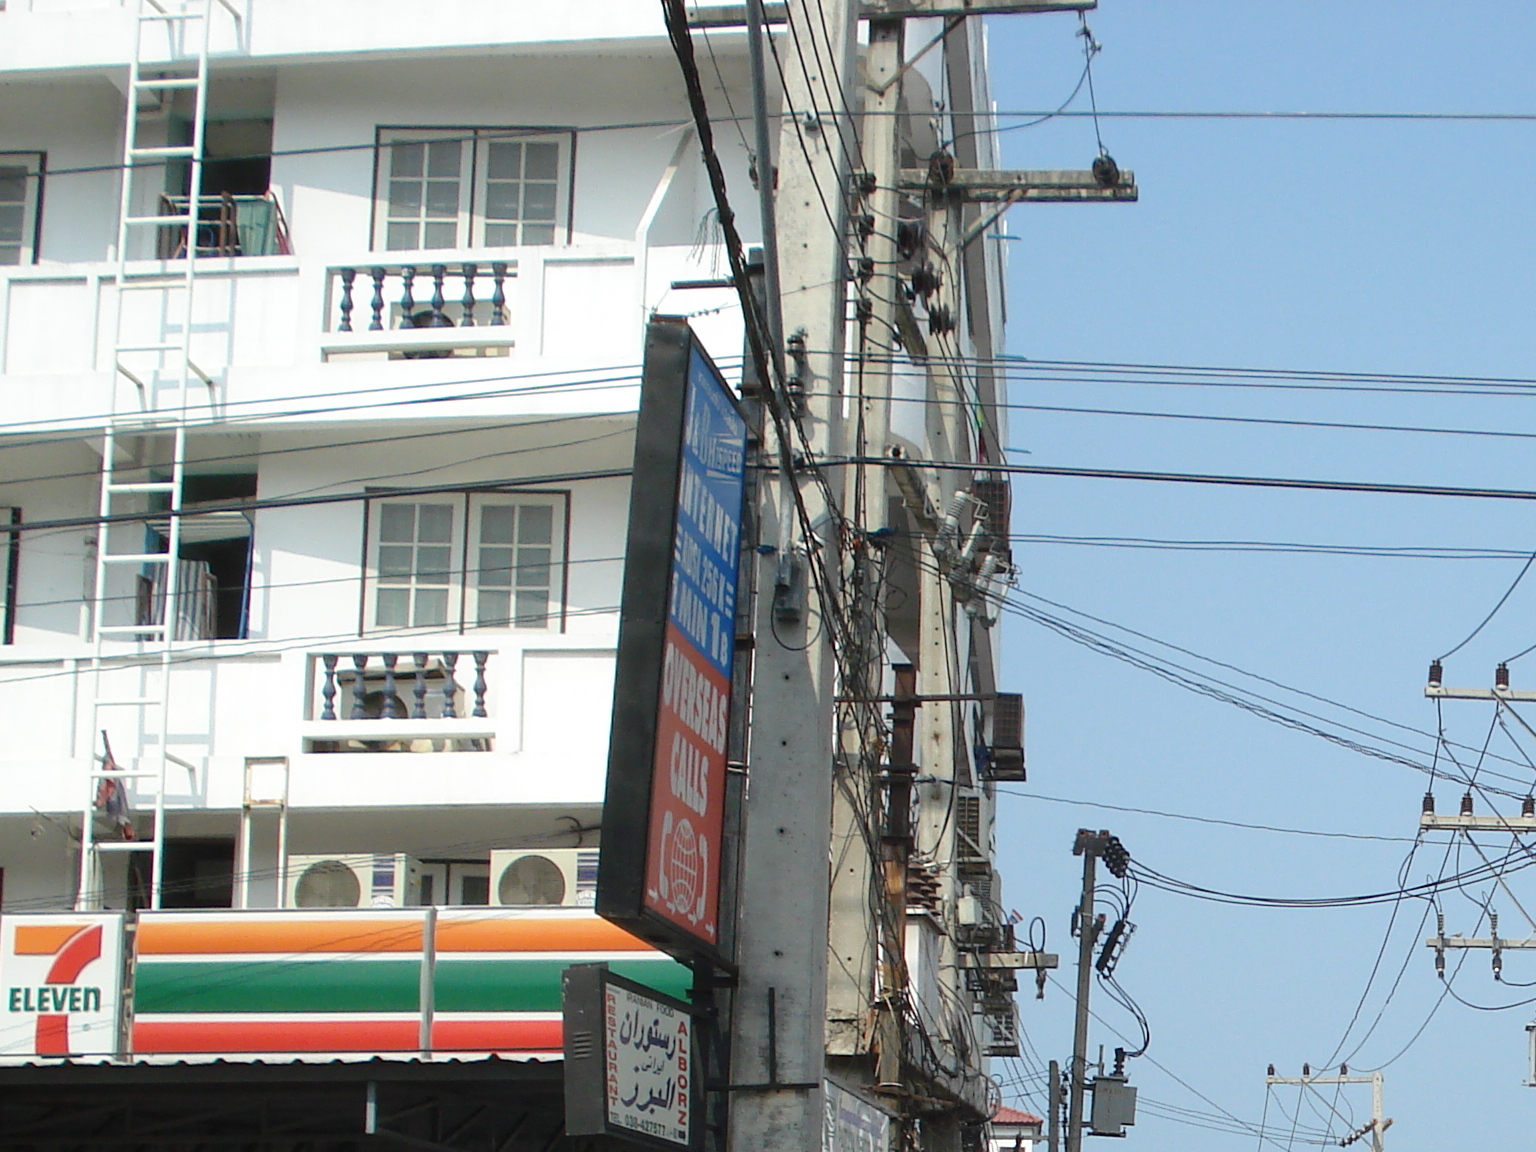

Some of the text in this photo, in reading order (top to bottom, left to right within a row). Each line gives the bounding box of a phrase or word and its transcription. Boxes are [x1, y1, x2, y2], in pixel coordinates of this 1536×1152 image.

[678, 457, 737, 569] INTERNET
[678, 580, 708, 649] MIN
[664, 641, 728, 755] OVERSEAS
[670, 731, 709, 817] CALLS
[8, 986, 101, 1012] ELEVEn
[14, 924, 103, 1054] 7
[656, 1003, 674, 1018] FOOD
[606, 994, 618, 1106] RESTAURANT
[620, 1009, 676, 1061] رستوران
[678, 1021, 688, 1126] ALBORZ
[620, 1066, 676, 1114] البرز
